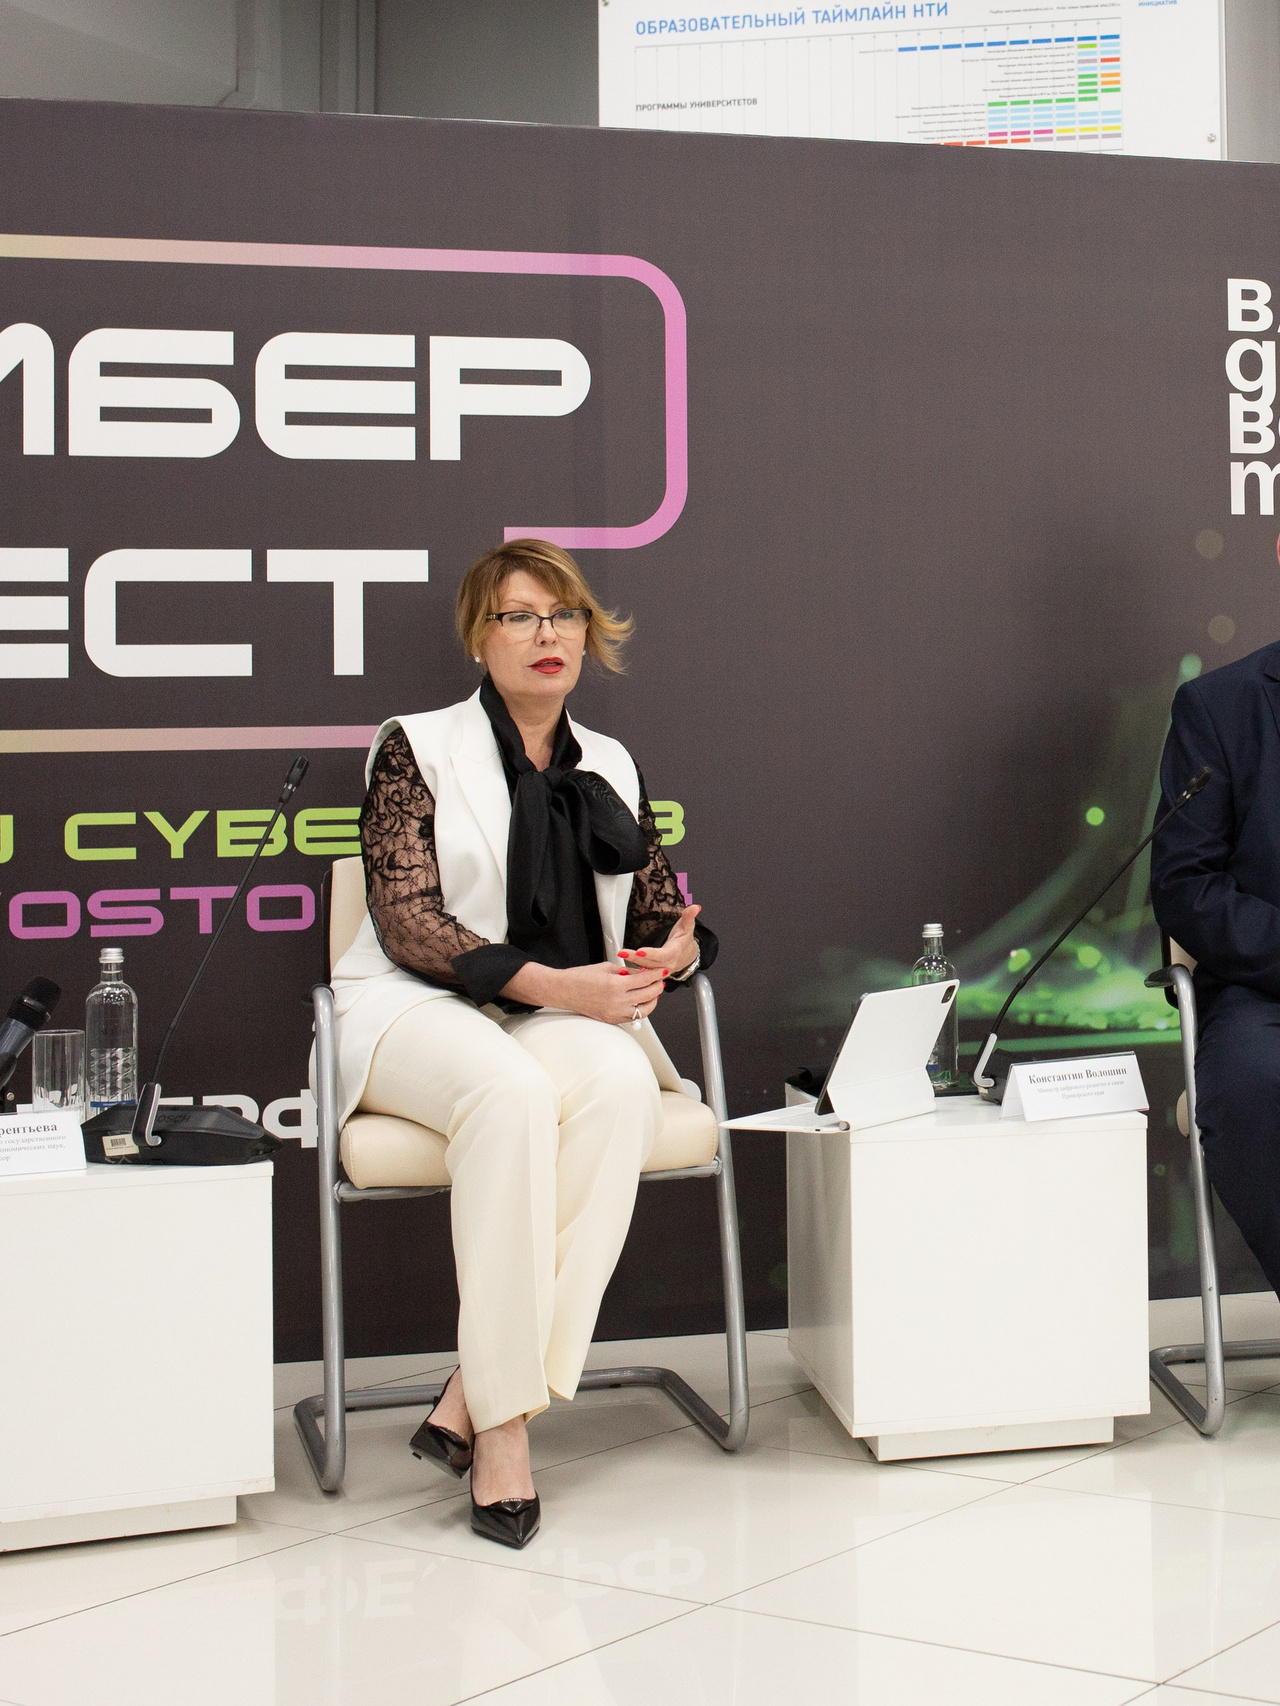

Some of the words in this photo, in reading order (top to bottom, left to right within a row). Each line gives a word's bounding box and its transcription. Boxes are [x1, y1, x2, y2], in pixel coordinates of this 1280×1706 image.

[636, 8, 806, 35] ОБРАЗОВАТЕЛЬНЫЙ
[812, 1, 906, 25] ТАЙМЛАЙН
[913, 2, 948, 18] НТИ
[636, 102, 687, 111] ПРОГРАММЫ
[690, 98, 758, 108] УНИВЕРСИТЕТОВ
[9, 883, 323, 940] OSTO
[1028, 1072, 1084, 1085] Константин
[1085, 1067, 1127, 1079] Волошин
[157, 1114, 191, 1123] OSCH
